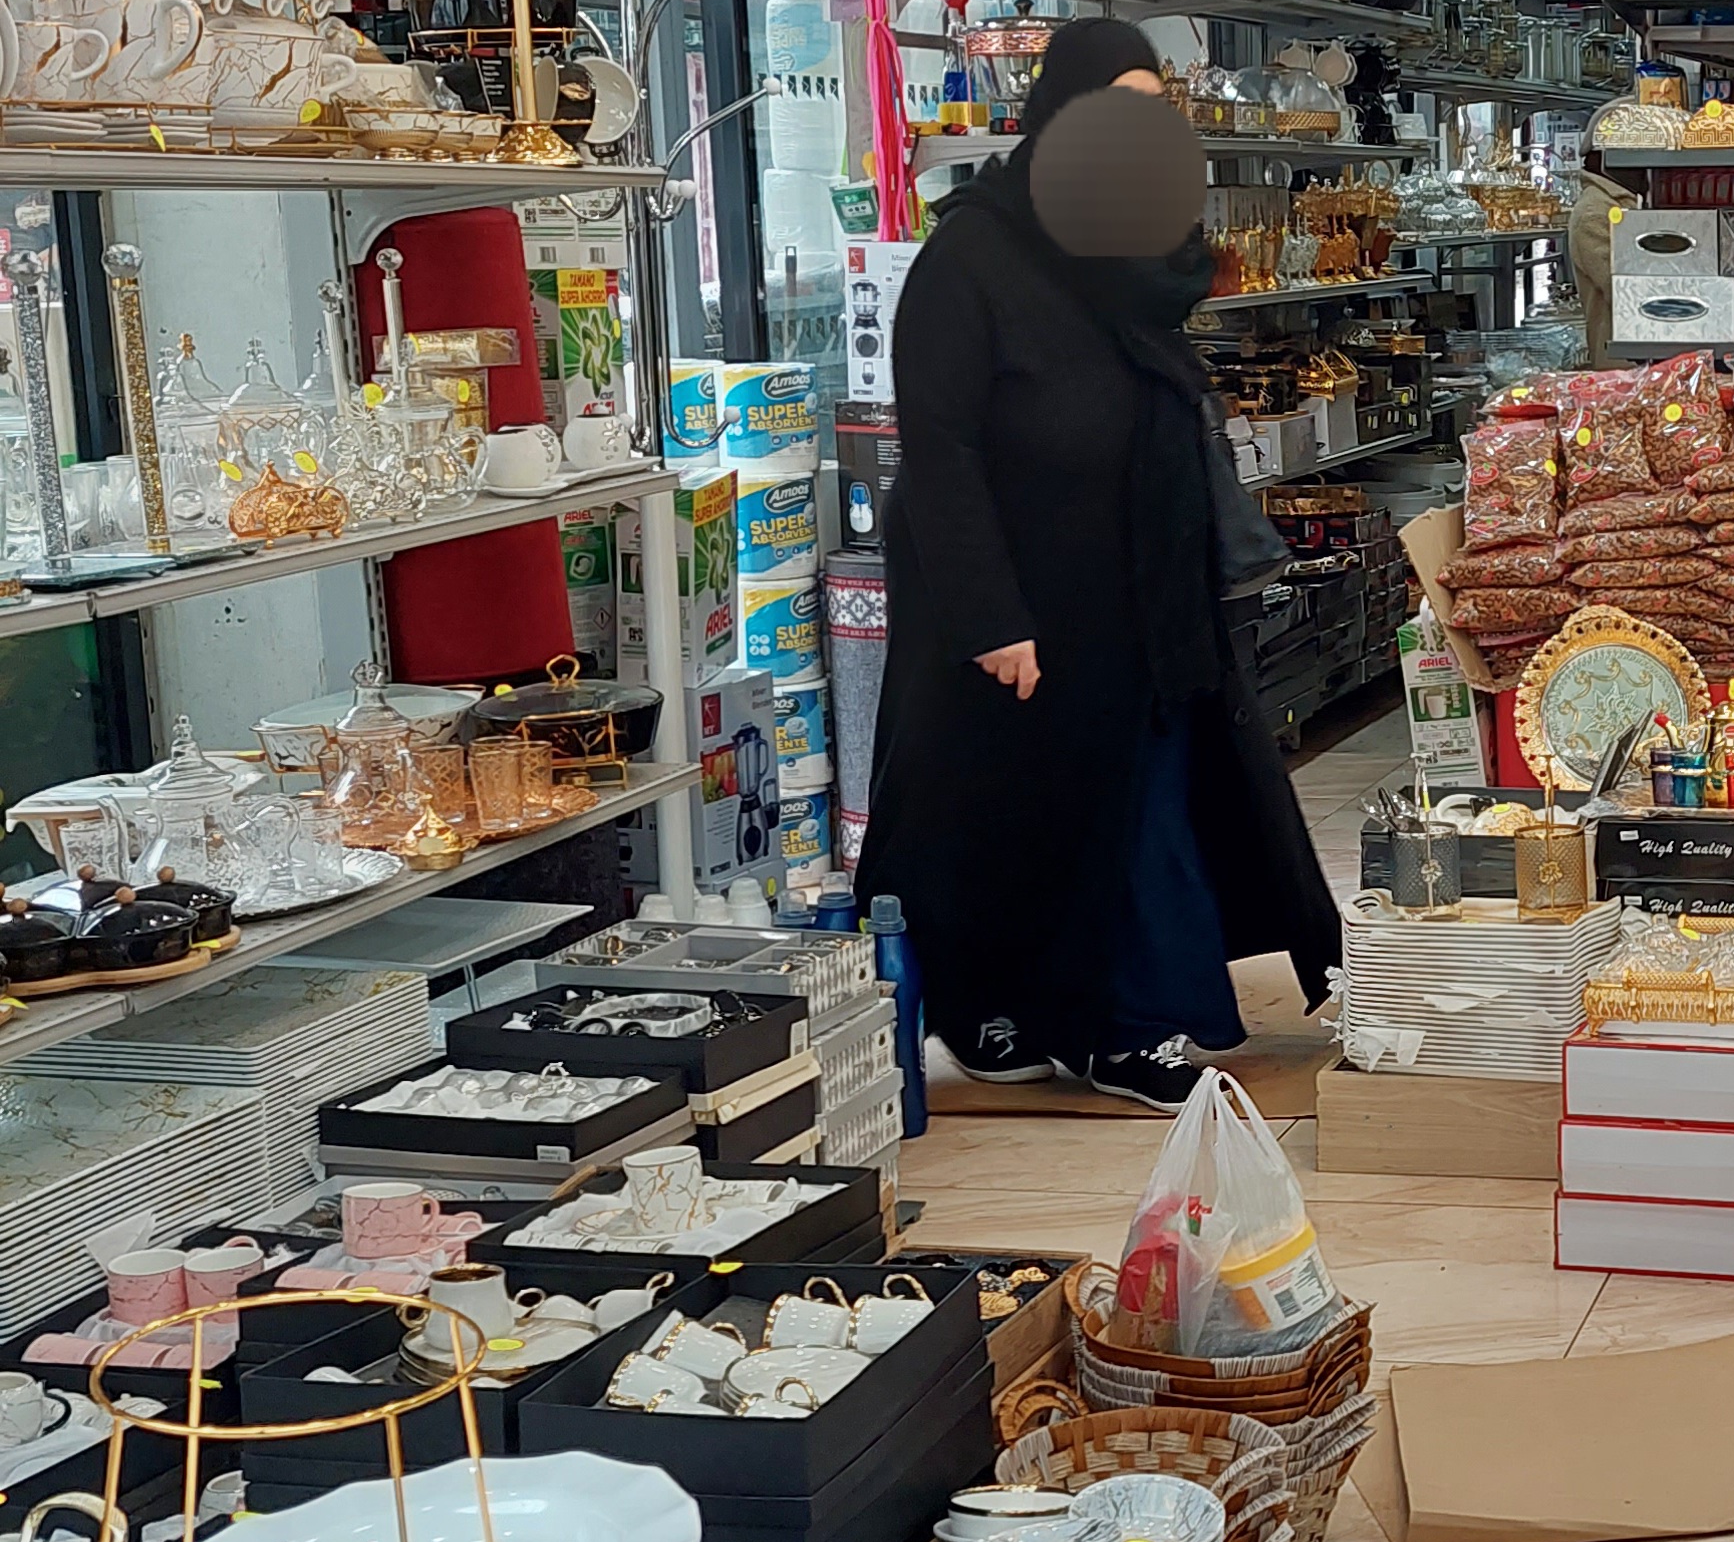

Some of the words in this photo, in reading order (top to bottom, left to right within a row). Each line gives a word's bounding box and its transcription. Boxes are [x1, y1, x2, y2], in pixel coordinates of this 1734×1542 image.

[767, 374, 811, 390] Amoos
[747, 403, 808, 421] SUPER
[768, 484, 809, 503] Amoos
[564, 510, 595, 522] ARIEL
[750, 514, 807, 535] SUPER
[706, 605, 733, 639] ARIEL
[776, 622, 818, 641] SUPE
[1418, 656, 1453, 669] ARIEL
[1638, 840, 1675, 858] High
[1681, 841, 1733, 858] Quality
[1649, 899, 1683, 914] High
